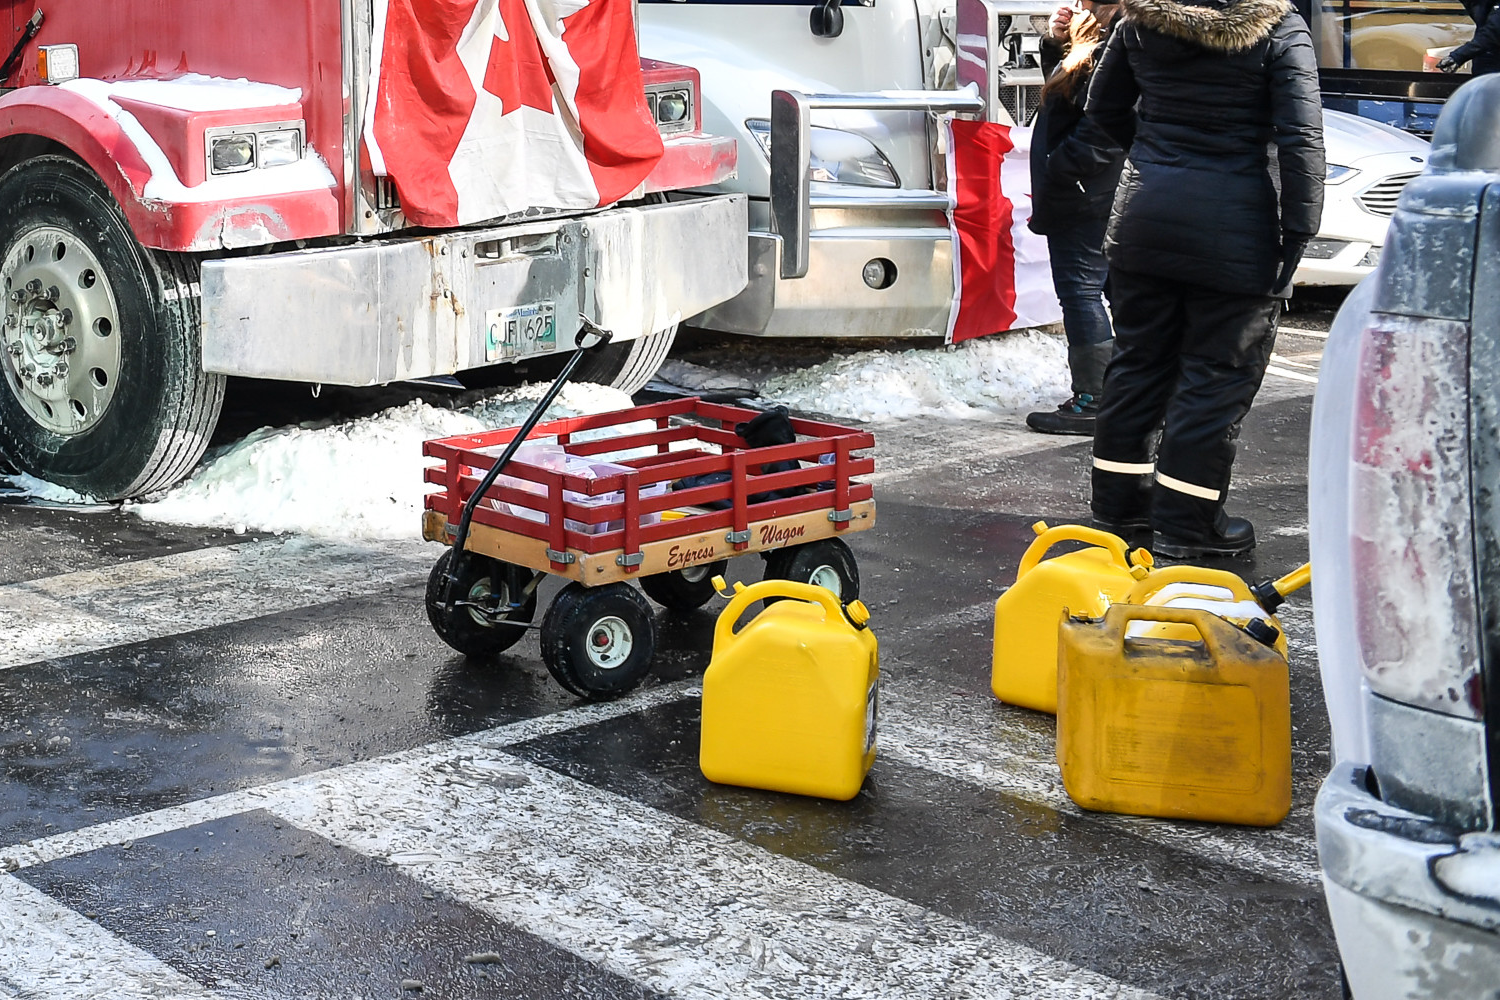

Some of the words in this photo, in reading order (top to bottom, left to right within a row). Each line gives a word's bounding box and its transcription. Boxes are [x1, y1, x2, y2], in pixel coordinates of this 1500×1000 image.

[490, 319, 517, 345] CJF
[524, 315, 553, 341] 625
[667, 545, 715, 568] Express
[760, 524, 806, 546] Wagon
